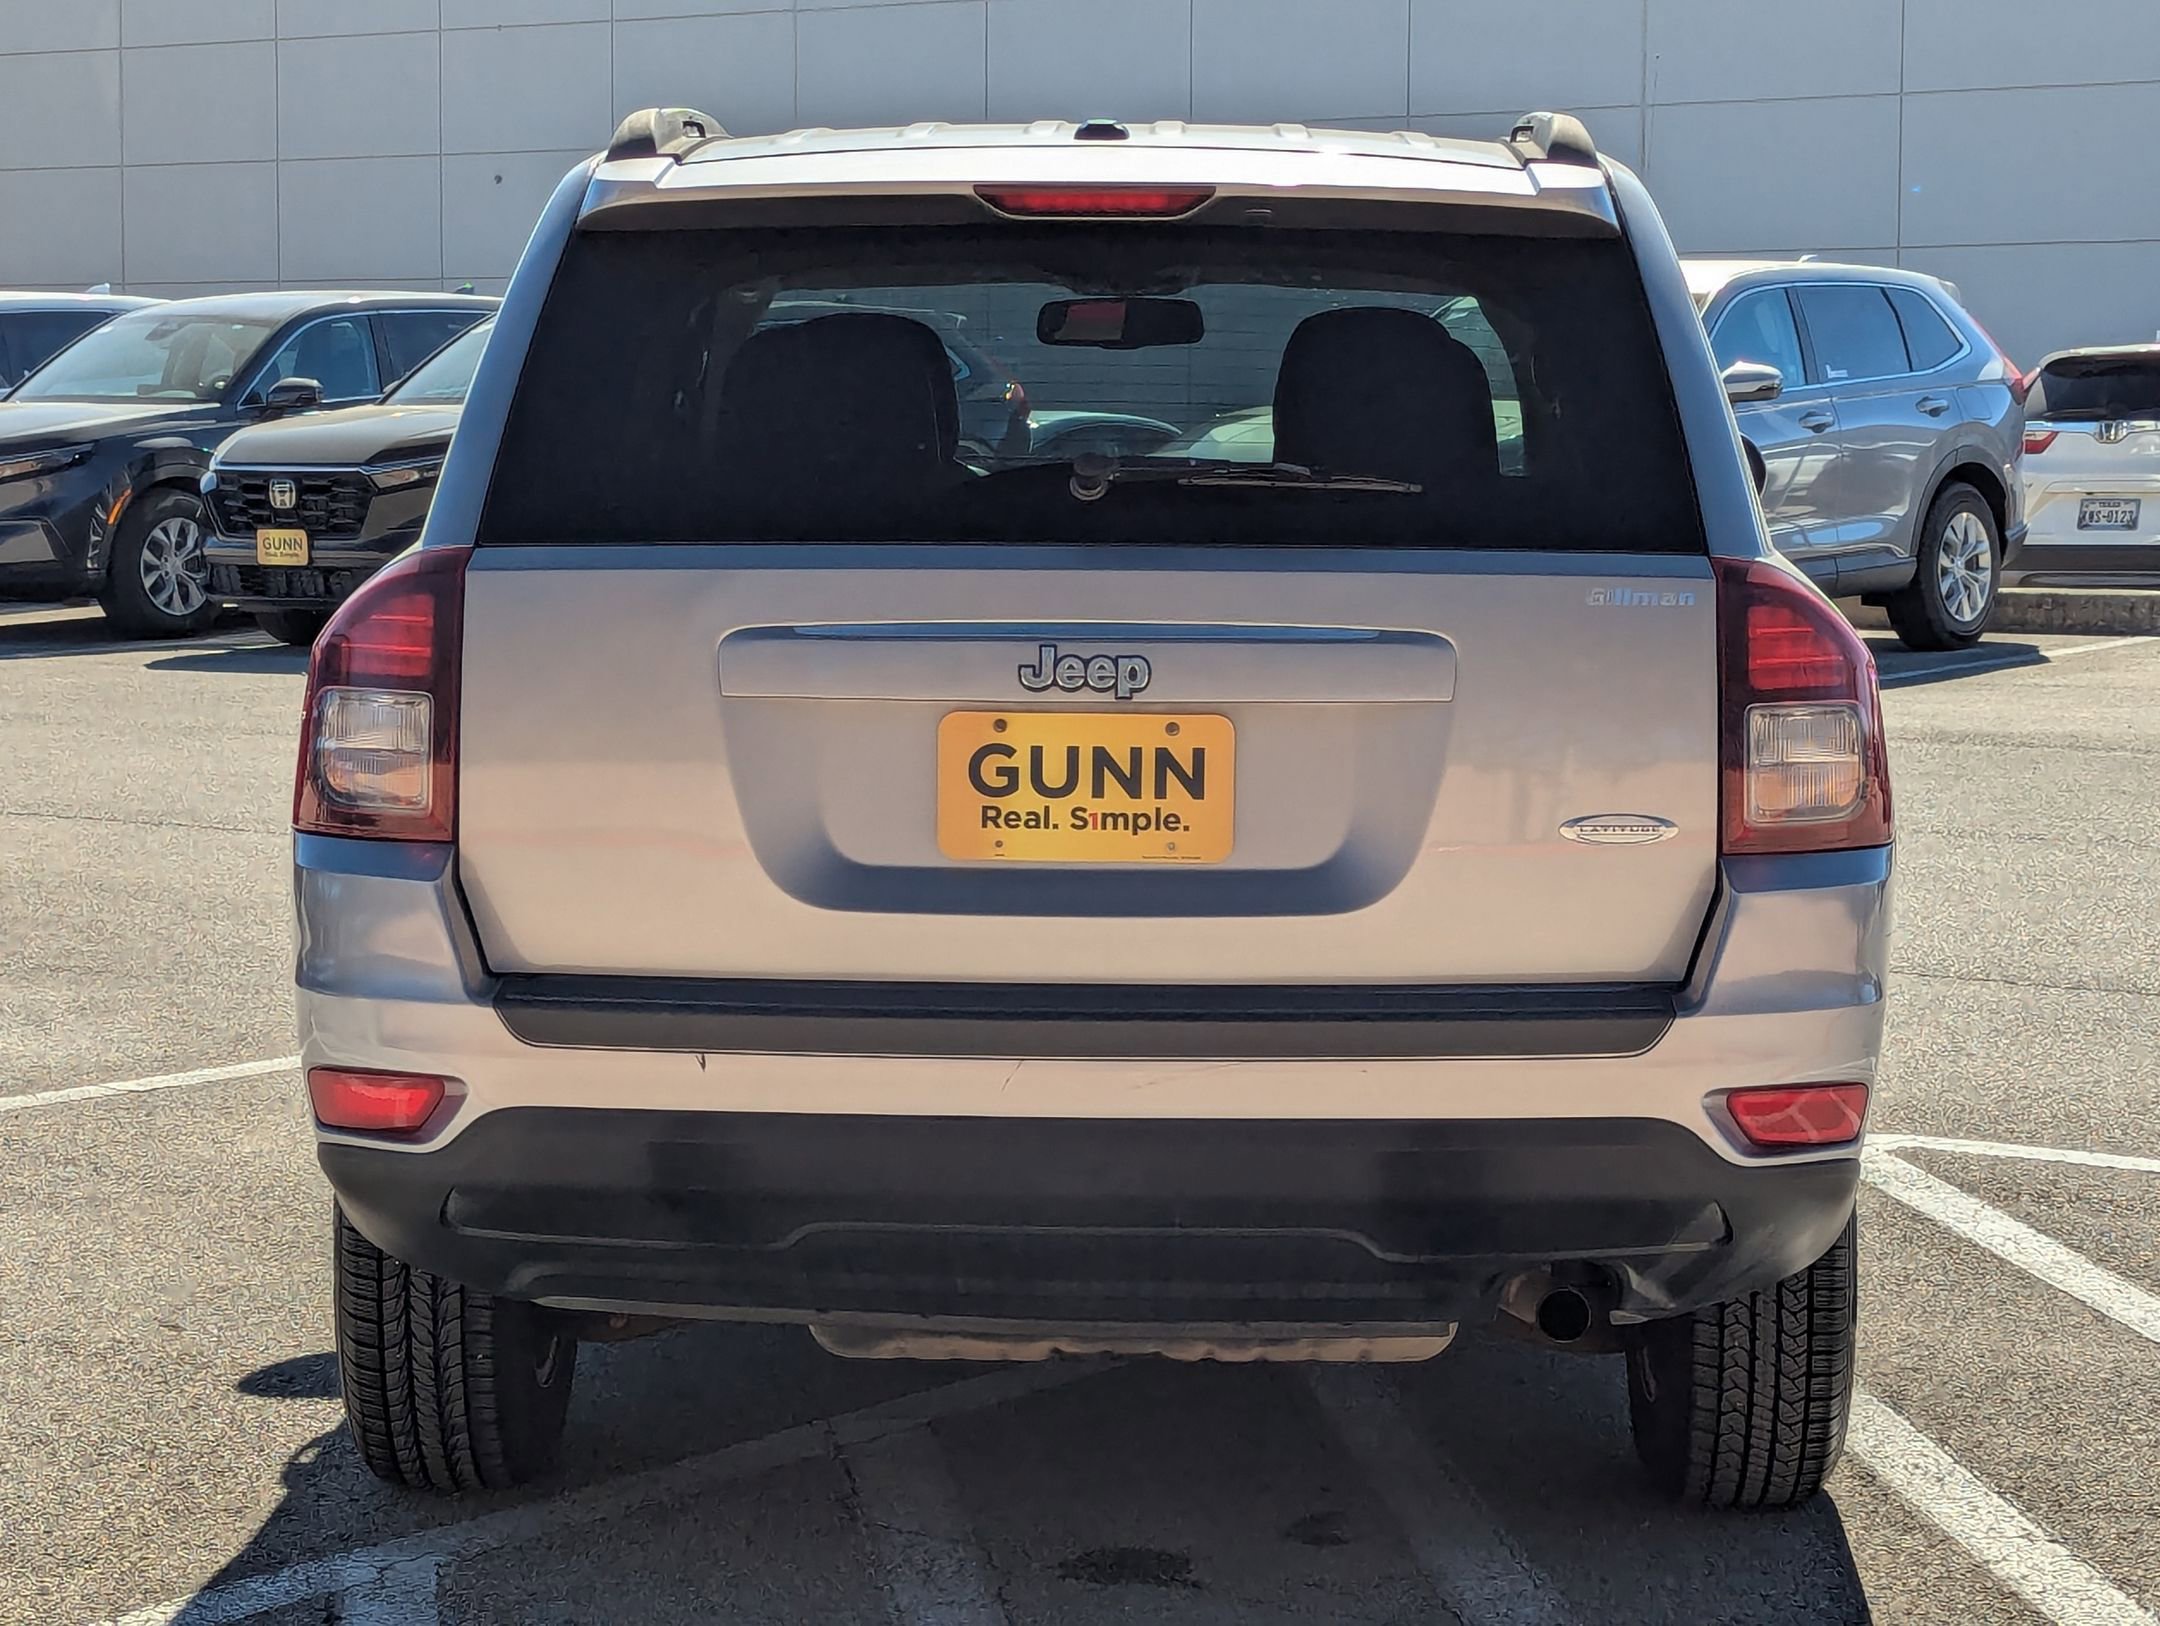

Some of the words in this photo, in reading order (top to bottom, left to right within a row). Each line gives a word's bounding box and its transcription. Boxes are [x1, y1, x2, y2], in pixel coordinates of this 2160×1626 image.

[262, 537, 303, 551] GUNN
[1017, 644, 1152, 700] Jeep
[968, 742, 1206, 801] GUNN
[981, 805, 1060, 830] Real.
[1580, 825, 1660, 833] LATITUDE
